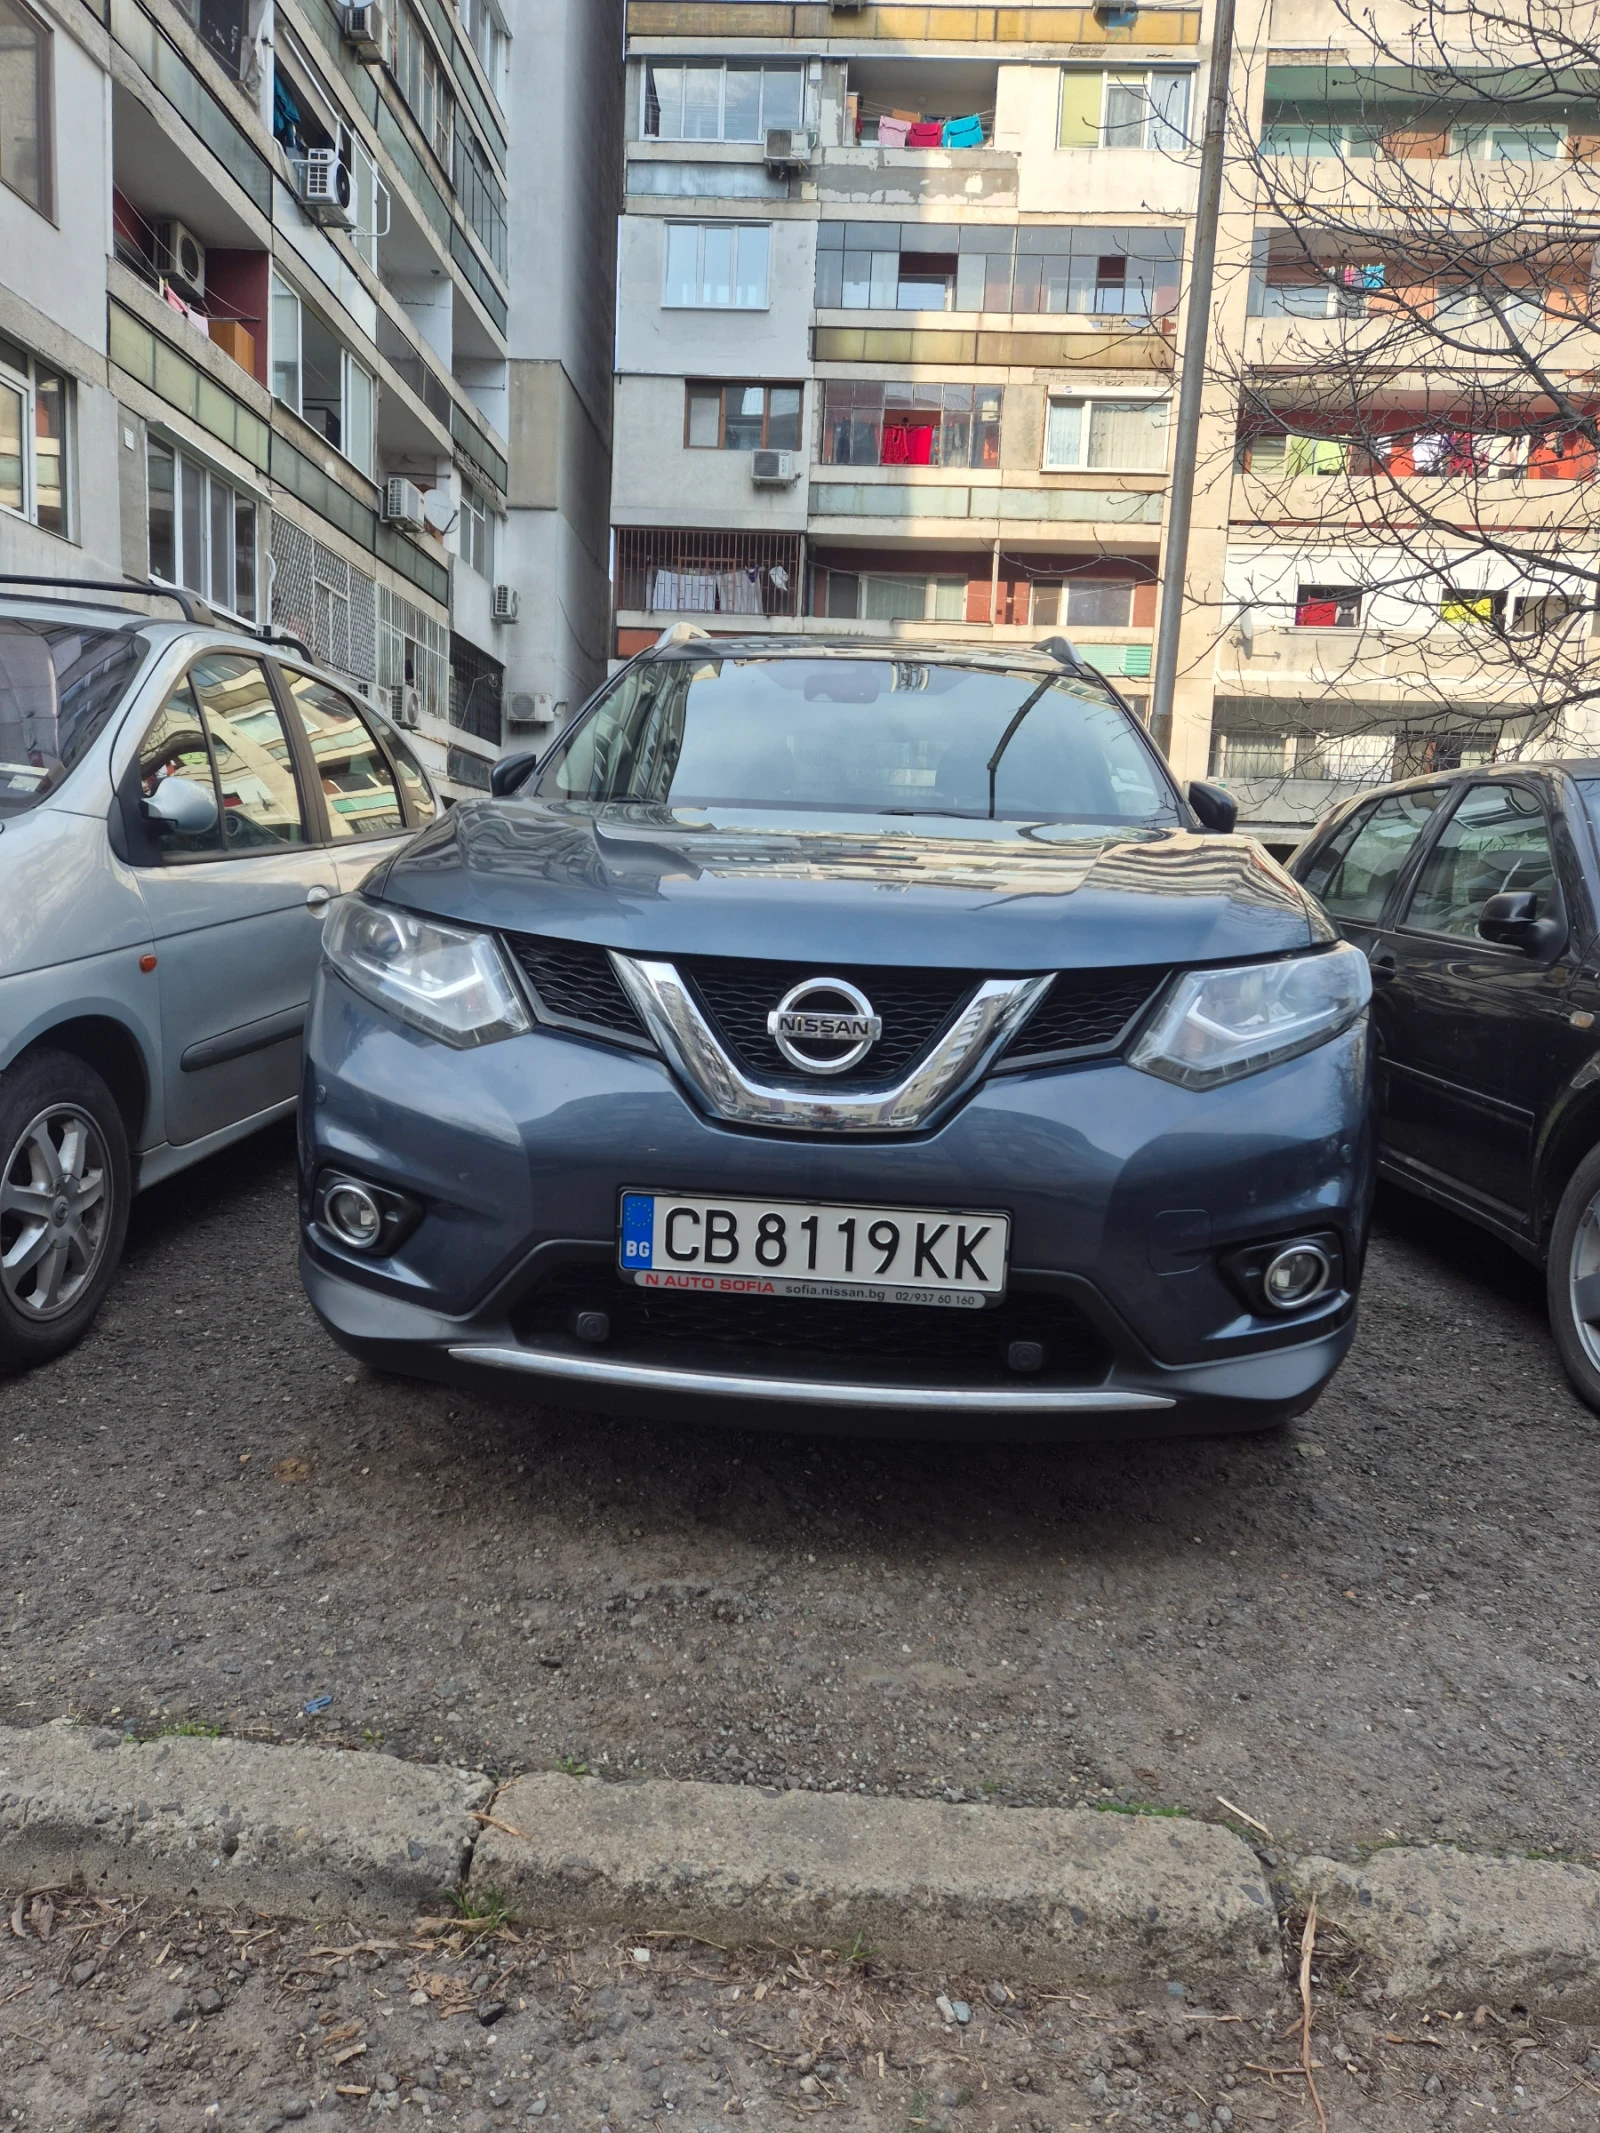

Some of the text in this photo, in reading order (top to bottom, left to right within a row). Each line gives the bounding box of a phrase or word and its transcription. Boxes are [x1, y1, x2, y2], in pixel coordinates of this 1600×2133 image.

[779, 1017, 869, 1035] NISSAN
[625, 1241, 650, 1258] BG
[664, 1276, 715, 1290] AUTO
[719, 1278, 775, 1294] SOFIA
[785, 1284, 886, 1301] sofia.nissan.bg
[895, 1291, 934, 1303] 02/937
[955, 1295, 975, 1306] 160
